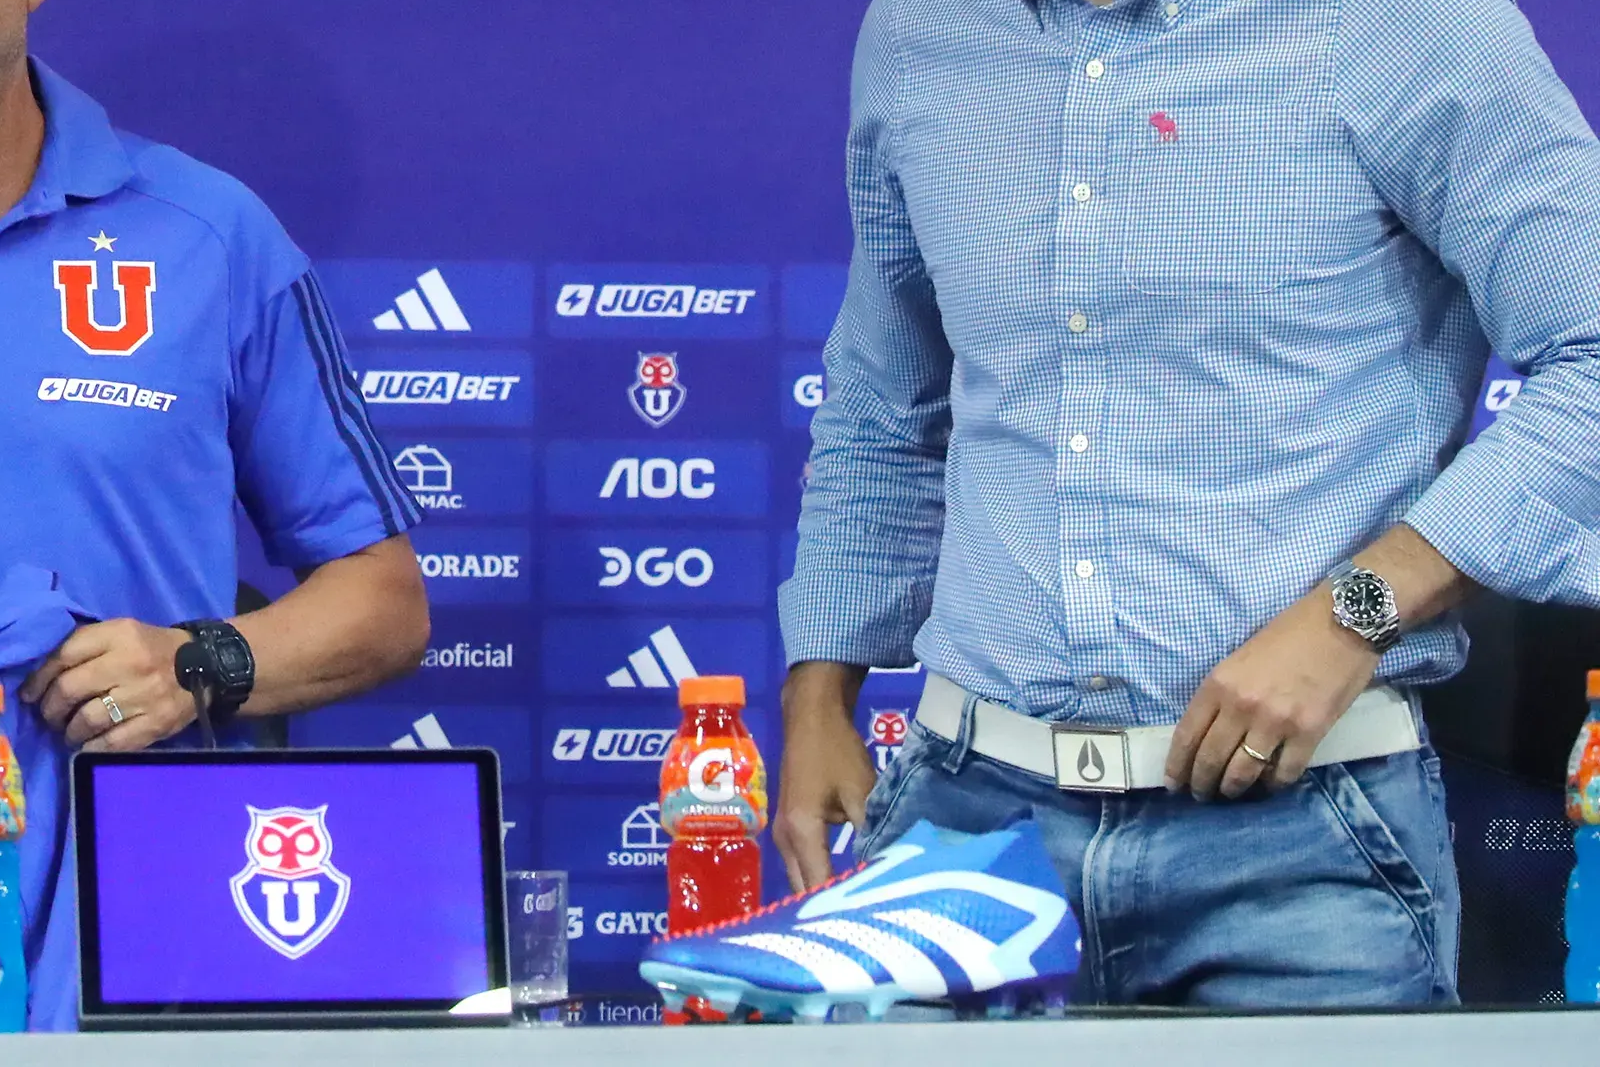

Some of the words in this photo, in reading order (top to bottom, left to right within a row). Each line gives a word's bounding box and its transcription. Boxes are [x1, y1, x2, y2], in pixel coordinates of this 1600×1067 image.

[53, 260, 157, 356] U
[642, 388, 671, 418] U
[599, 458, 716, 500] AOC
[417, 554, 520, 578] ORADE
[420, 642, 514, 668] aoficial
[688, 747, 736, 803] G
[607, 851, 668, 867] SODIM
[261, 880, 320, 936] U
